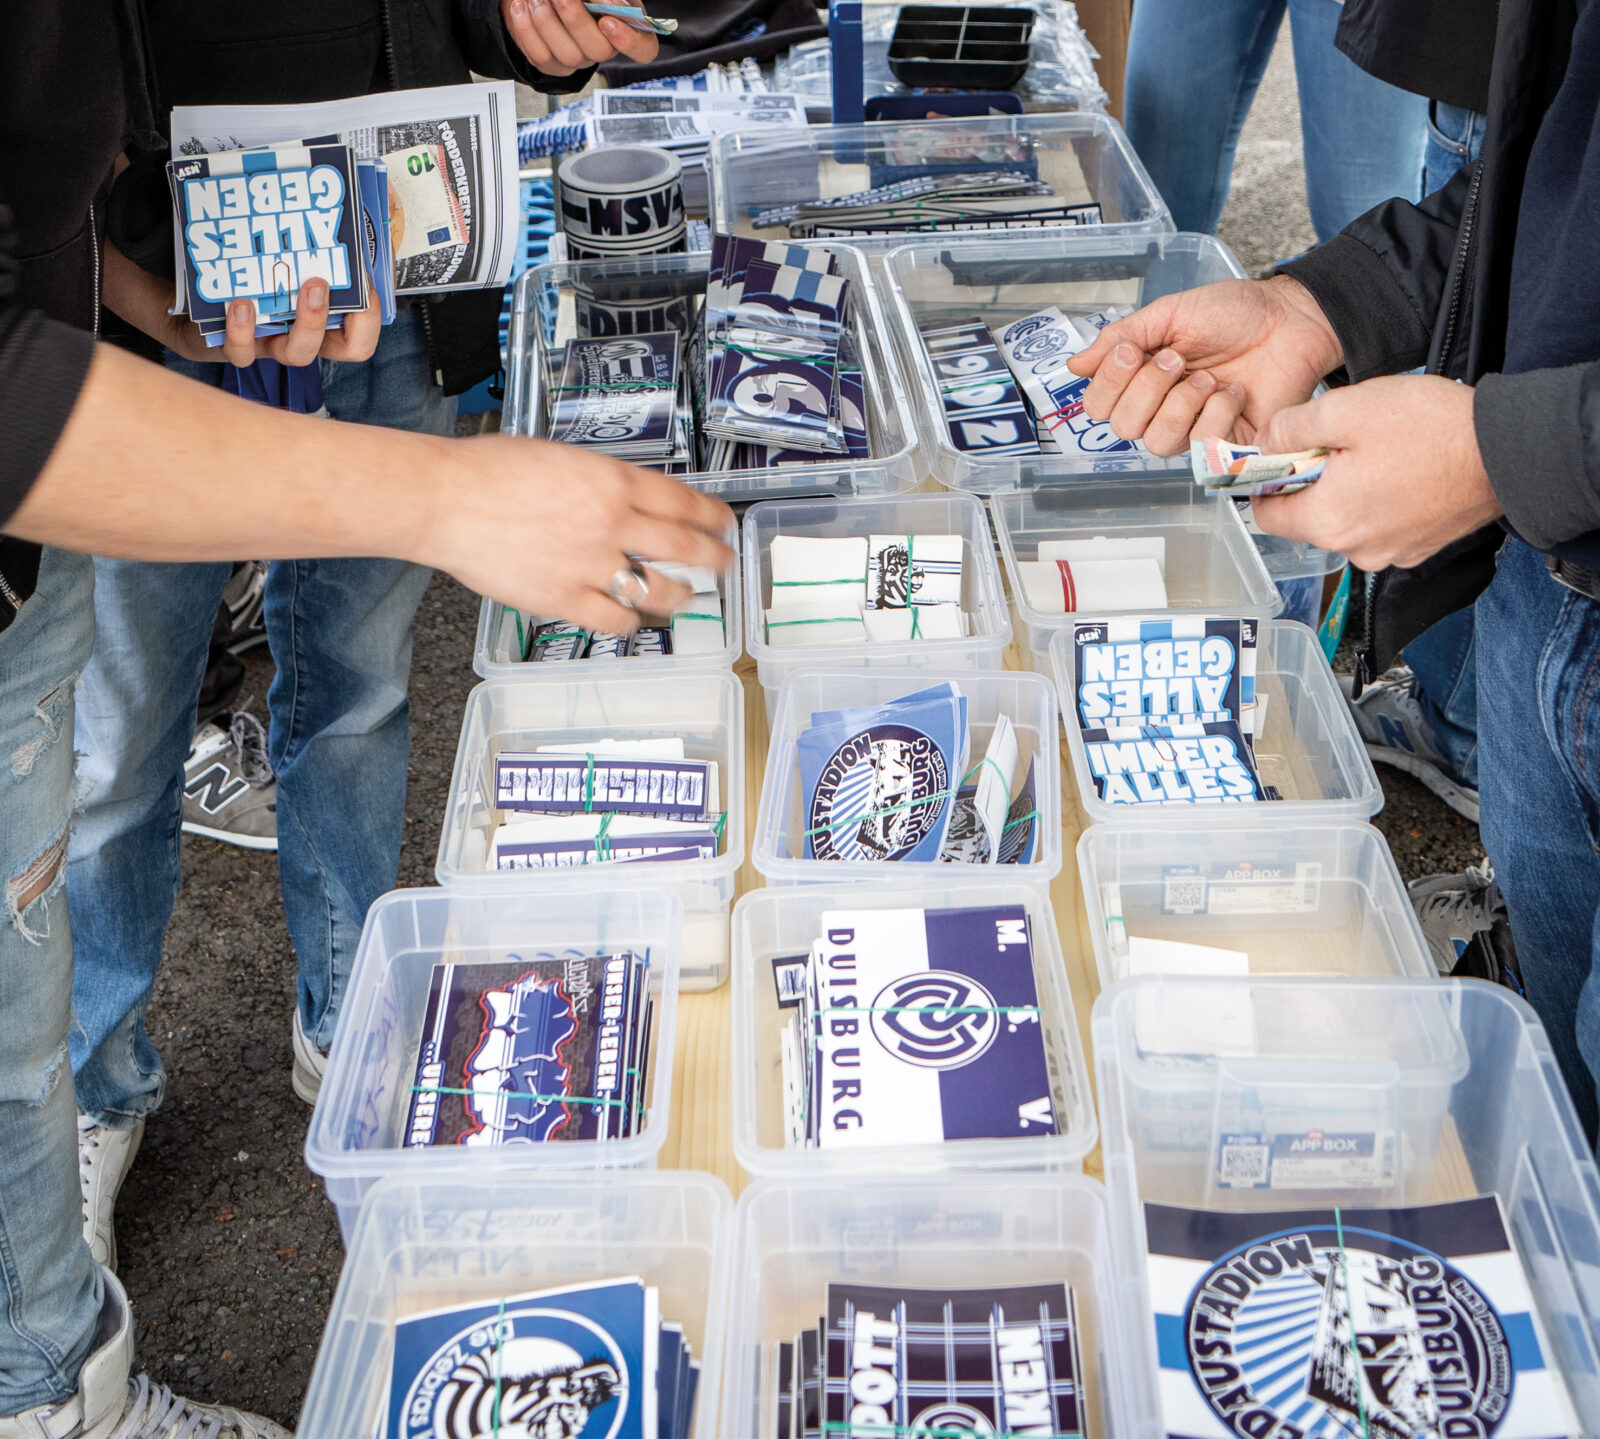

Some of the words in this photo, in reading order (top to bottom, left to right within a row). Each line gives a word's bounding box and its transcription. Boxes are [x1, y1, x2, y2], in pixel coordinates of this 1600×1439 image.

[406, 151, 436, 177] 10
[186, 166, 344, 222] GEBEN
[587, 184, 674, 237] MSV
[188, 207, 342, 262] ALLES
[197, 245, 349, 302] IMMER
[1084, 638, 1234, 682] GEBEN
[1081, 674, 1231, 719] ALLES
[1086, 736, 1241, 776] IMMER
[901, 736, 931, 851] DUISBURG
[1103, 765, 1256, 804] ALLES
[1224, 869, 1251, 881] APP
[1253, 869, 1281, 881] BOX
[602, 959, 626, 1020] UNSER
[827, 927, 863, 1131] DUISBURG
[1290, 1139, 1321, 1151] APP
[1323, 1138, 1358, 1151] BOX
[468, 1318, 515, 1348] Die
[410, 1343, 470, 1429] Zebras
